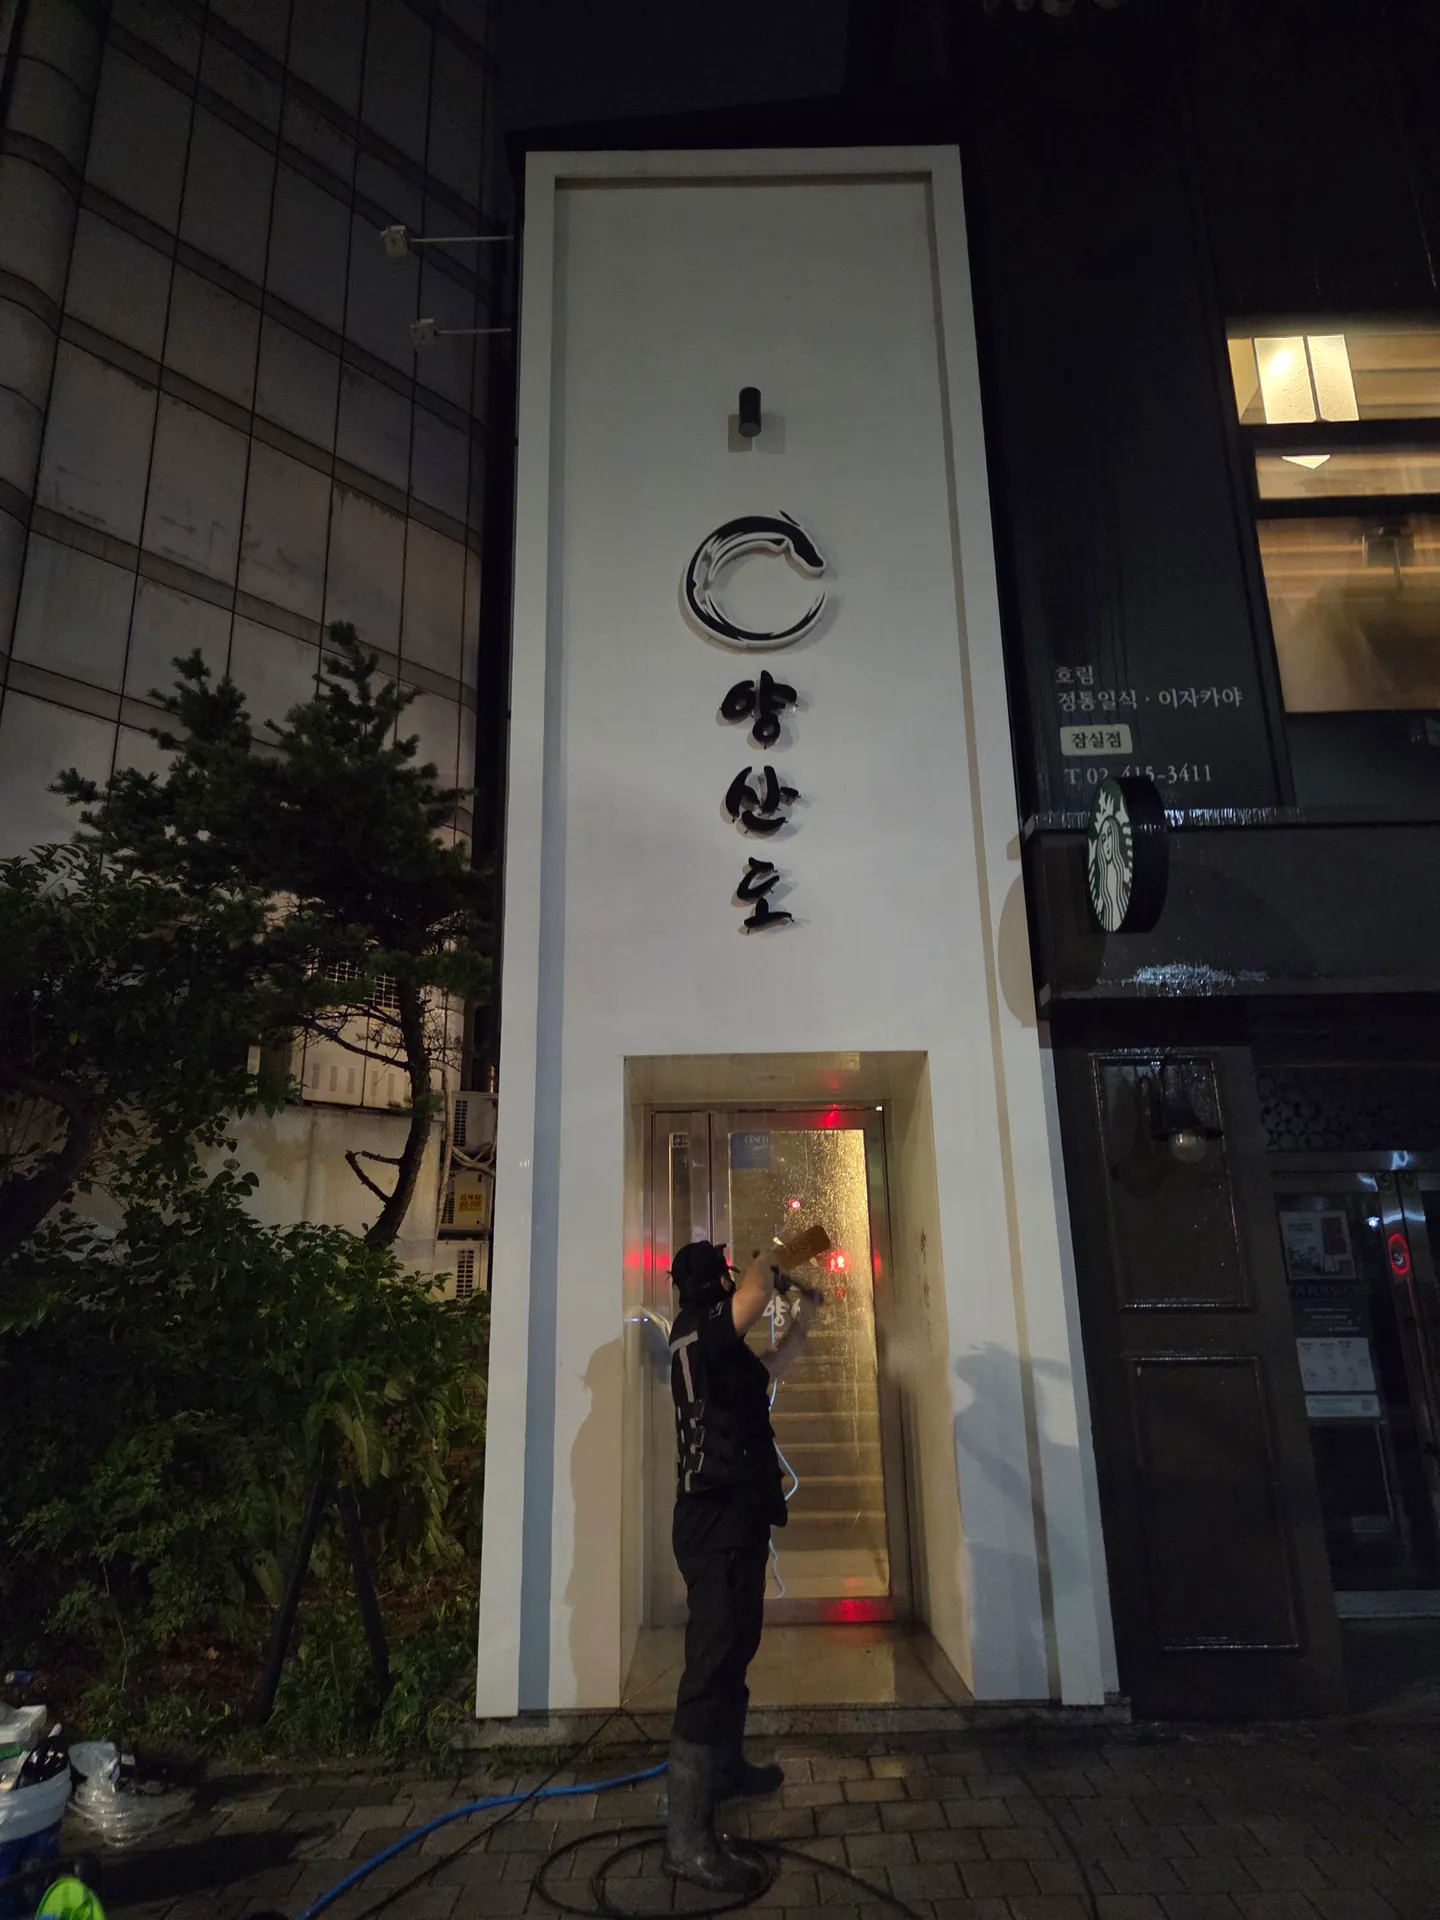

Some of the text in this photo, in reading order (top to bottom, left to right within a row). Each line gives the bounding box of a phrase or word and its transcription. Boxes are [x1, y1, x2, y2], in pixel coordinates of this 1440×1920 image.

[1055, 665, 1094, 686] 호림
[1057, 688, 1138, 712] 정통일식
[1158, 686, 1243, 710] 이자카야
[1071, 731, 1122, 749] 잠실점
